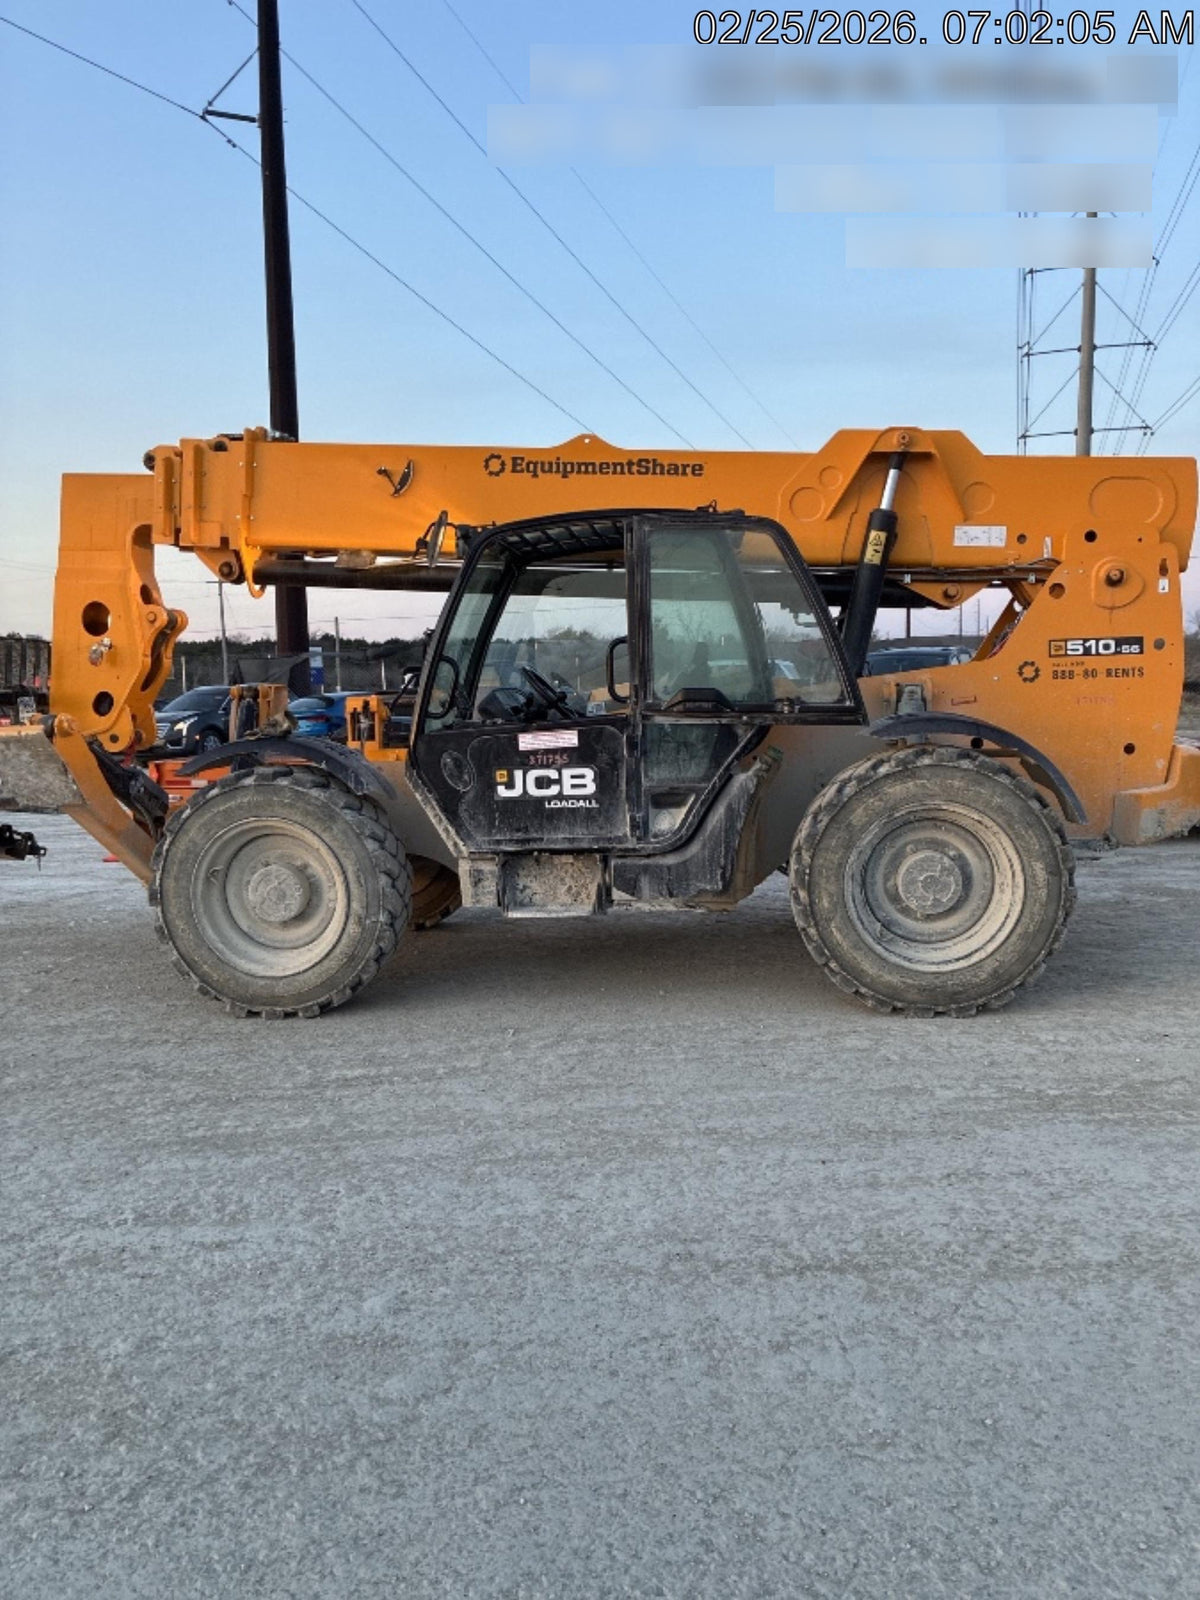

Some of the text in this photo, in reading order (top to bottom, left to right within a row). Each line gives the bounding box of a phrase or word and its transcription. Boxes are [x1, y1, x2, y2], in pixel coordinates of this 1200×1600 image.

[511, 456, 705, 478] EquipmentShare
[496, 768, 597, 797] JCB
[545, 799, 600, 809] LOADALL
